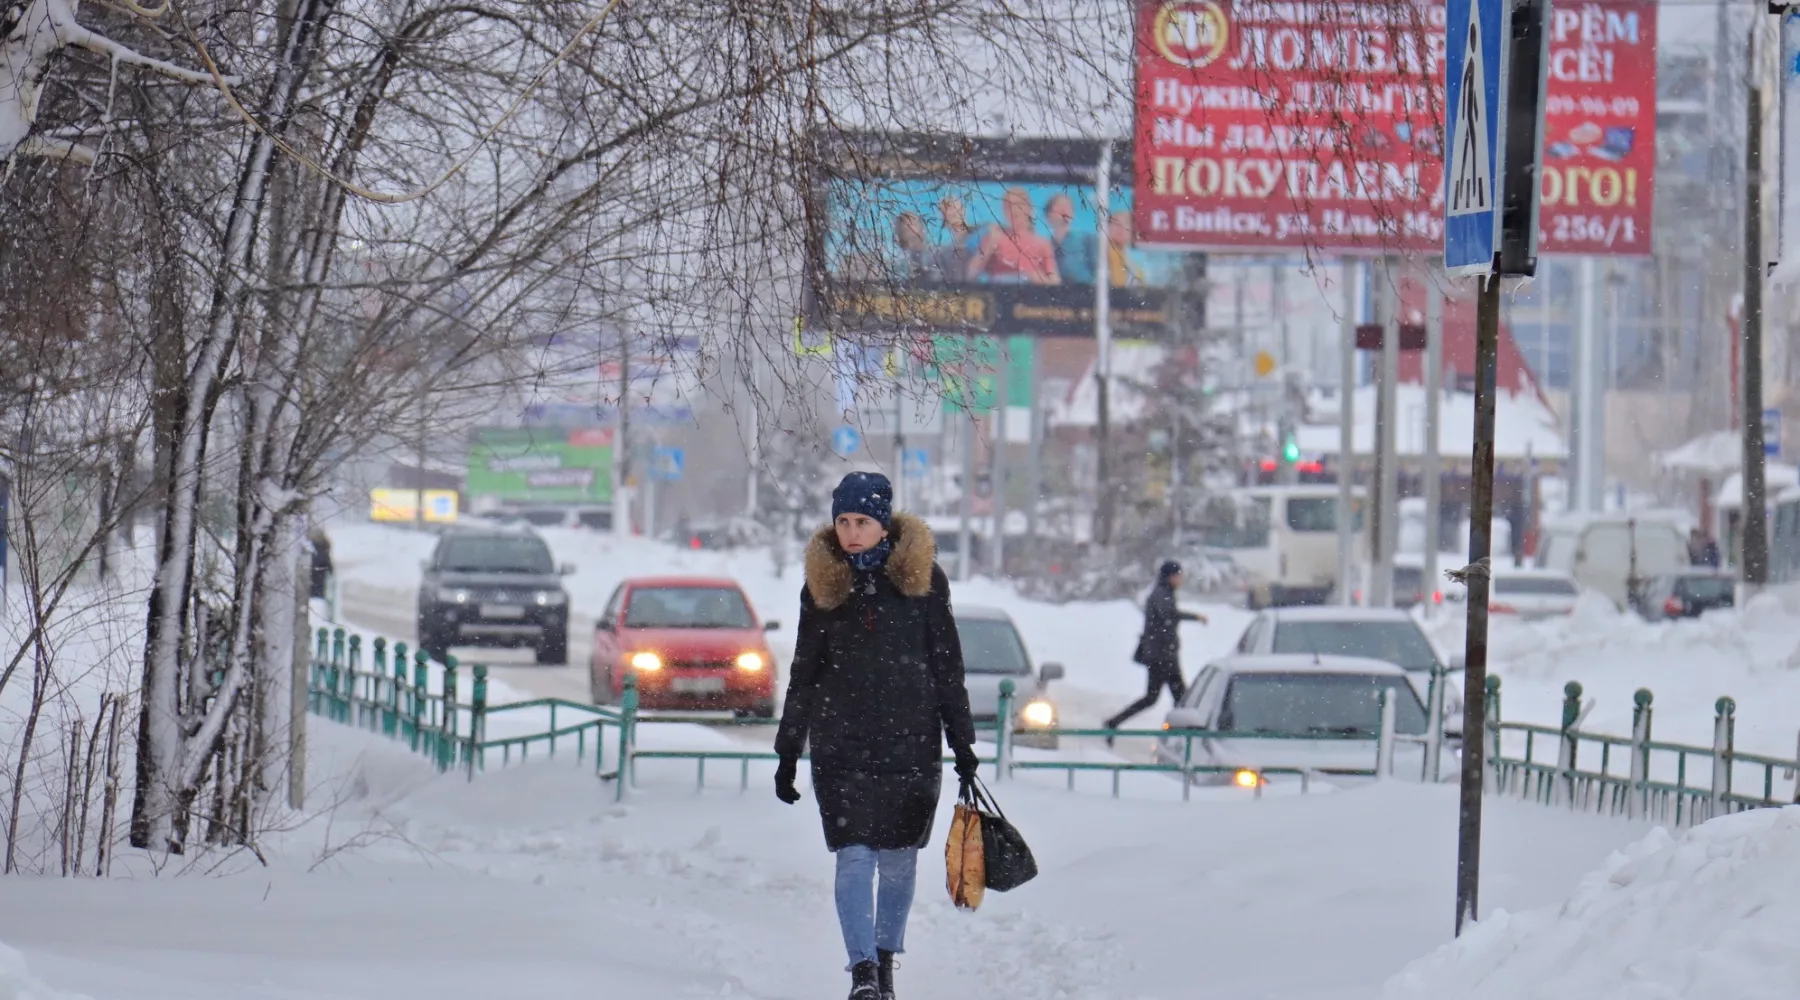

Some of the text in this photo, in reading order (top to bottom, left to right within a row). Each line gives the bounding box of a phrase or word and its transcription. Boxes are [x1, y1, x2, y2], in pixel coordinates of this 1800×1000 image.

[1549, 4, 1639, 45] РЁМ
[1229, 26, 1446, 74] ЛОМБАР
[1547, 41, 1614, 83] СЁ!
[1153, 116, 1215, 147] Мы
[1153, 156, 1421, 201] ПОКУПАЕМ
[1541, 166, 1638, 208] ОГО!
[1152, 209, 1169, 231] г.
[1403, 211, 1446, 241] Му
[1553, 215, 1637, 247] 256/1
